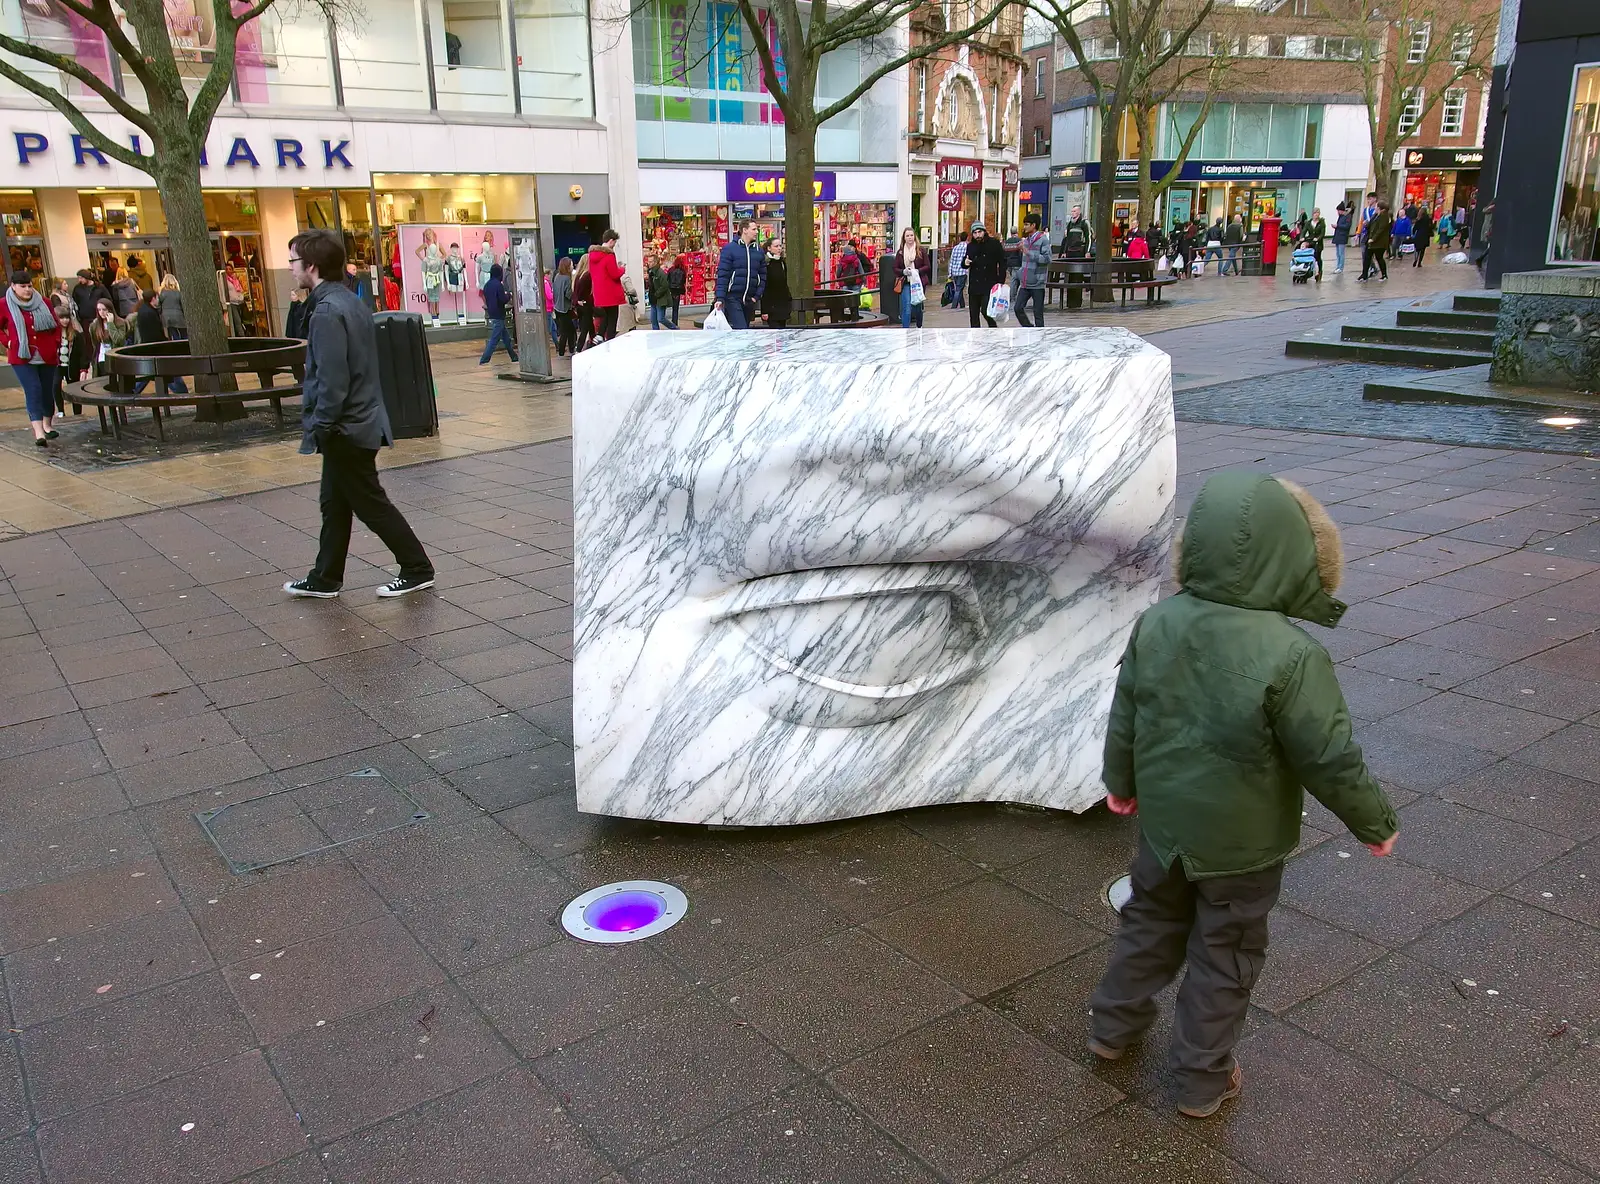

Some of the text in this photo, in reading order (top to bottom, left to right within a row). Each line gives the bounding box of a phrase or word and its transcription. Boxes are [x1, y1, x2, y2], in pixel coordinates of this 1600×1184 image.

[724, 11, 741, 91] GIFTS
[14, 132, 354, 169] PRIARK
[1116, 164, 1139, 172] rphone
[1206, 165, 1241, 175] Carphone
[1242, 165, 1283, 174] Warehouse
[745, 177, 776, 194] Card
[411, 293, 427, 303] £10
